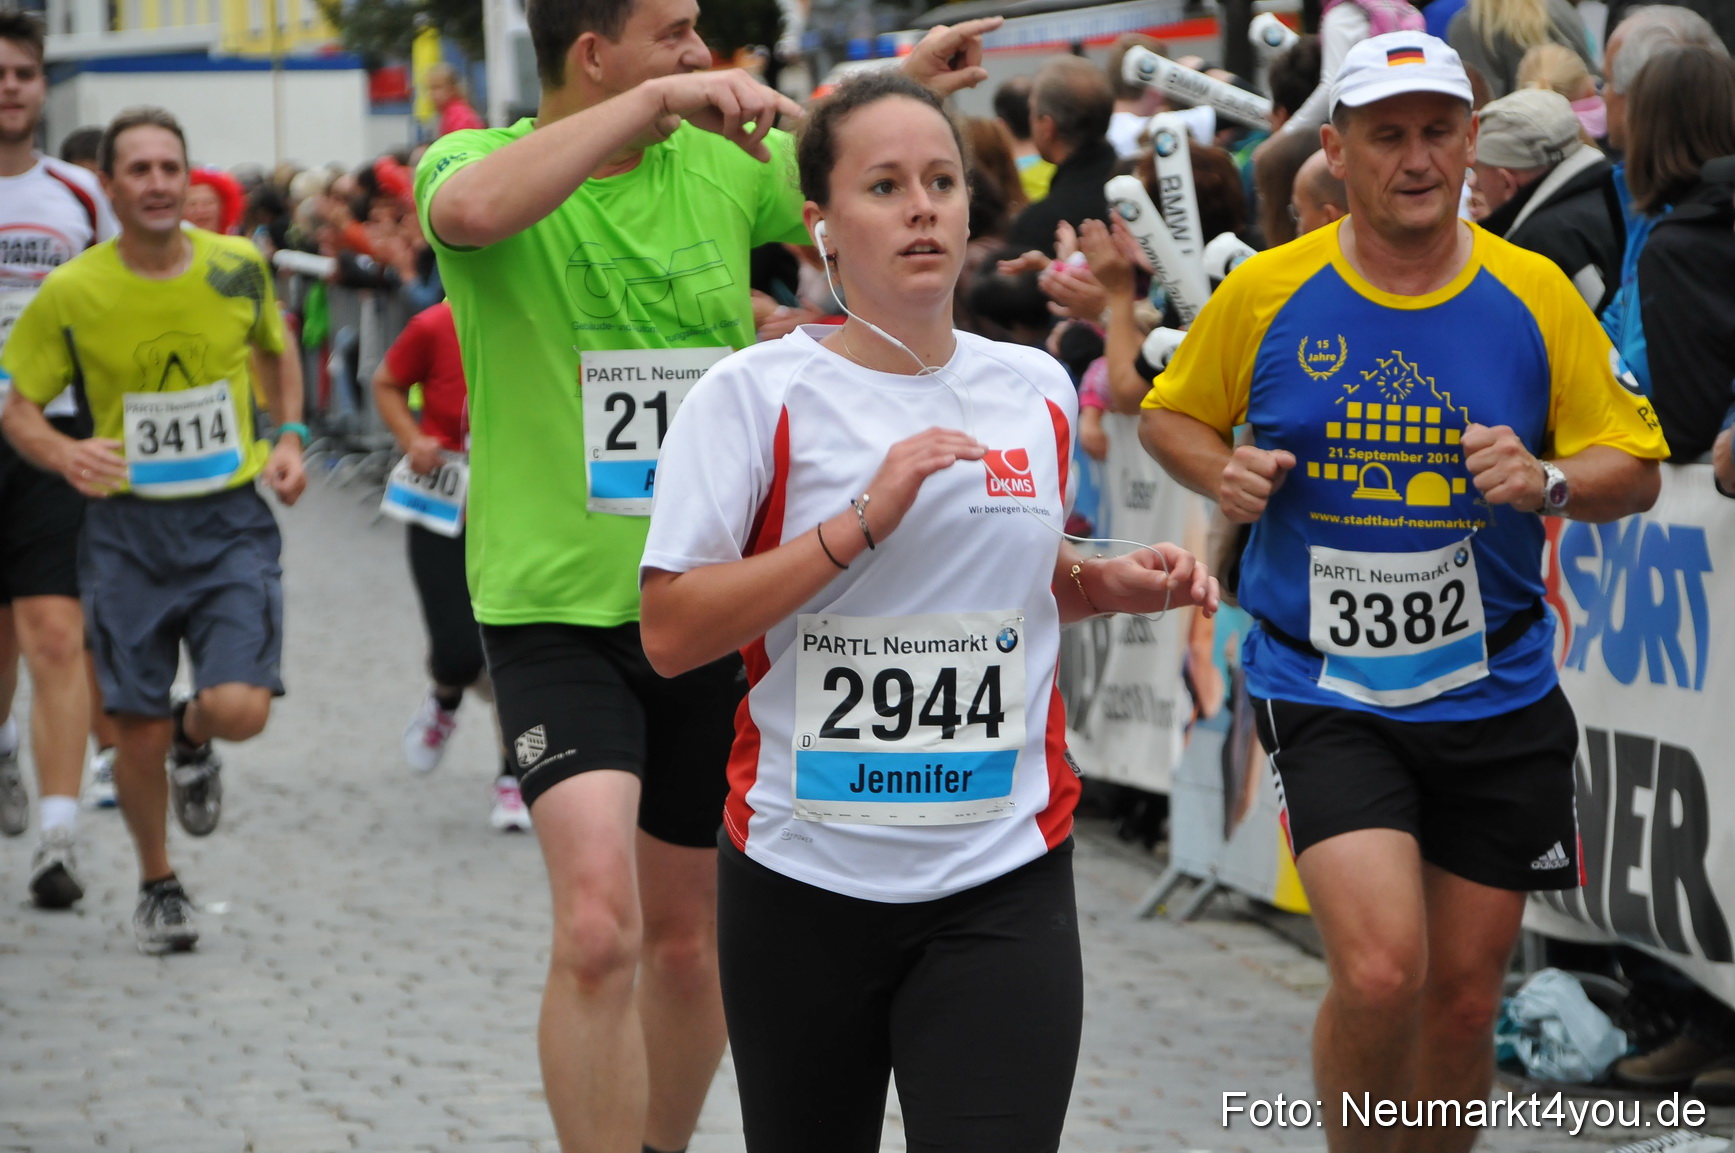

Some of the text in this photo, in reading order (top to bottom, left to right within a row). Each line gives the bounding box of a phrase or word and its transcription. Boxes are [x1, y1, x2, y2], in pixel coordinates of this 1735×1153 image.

[1316, 339, 1330, 349] 15
[1308, 352, 1337, 363] Jahre
[586, 367, 646, 382] PARTL
[604, 389, 684, 451] 21
[136, 407, 228, 455] 3414
[1328, 446, 1460, 464] 21.September 2014
[990, 478, 1033, 493] DKMS
[968, 506, 983, 514] Wir
[984, 504, 1021, 515] besiegen
[1309, 511, 1487, 529] www.stadtlauf-neumarkt.de
[1314, 561, 1450, 583] PARTL Neumarkt
[1329, 578, 1470, 648] 3382
[803, 633, 988, 656] PARTL Neumarkt
[819, 664, 1005, 741] 2944
[802, 735, 811, 748] D
[849, 763, 973, 794] Jennifer
